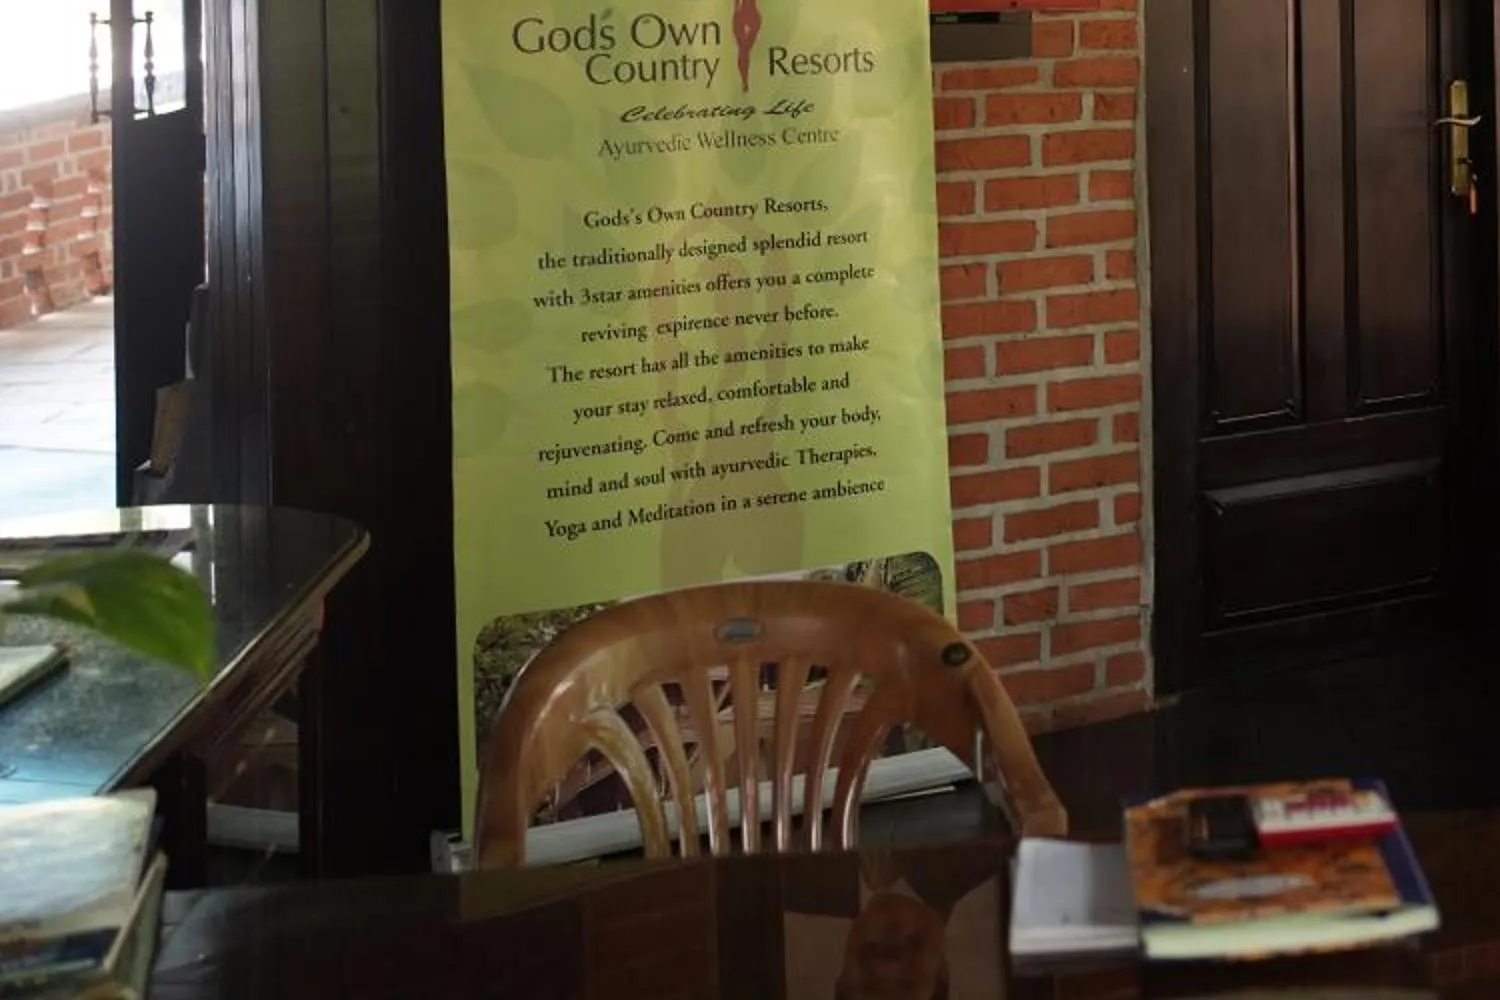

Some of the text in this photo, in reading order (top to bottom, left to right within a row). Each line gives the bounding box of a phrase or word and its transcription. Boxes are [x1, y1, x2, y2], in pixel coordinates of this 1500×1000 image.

[511, 10, 721, 55] God's Own
[585, 46, 875, 89] Country Resorts
[619, 98, 815, 123] Celebrating Life
[598, 127, 840, 162] Ayurvedic Wellness Centre
[647, 206, 686, 224] Own
[689, 202, 759, 220] Country
[538, 230, 868, 271] the traditionally designed splendid resort
[532, 263, 875, 308] with 3star amenities offers you a complete
[581, 302, 839, 343] reviving expirence never before.
[548, 334, 870, 384] The resort has all the amenities to make
[573, 405, 614, 425] your
[617, 399, 649, 417] stay
[716, 375, 817, 401] comfortable
[821, 371, 850, 391] and
[652, 429, 700, 447] Come
[704, 419, 736, 441] and
[739, 414, 795, 436] refresh
[799, 414, 837, 435] your
[546, 476, 593, 500] mind
[598, 471, 630, 493] and
[633, 465, 666, 487] soul
[669, 460, 706, 482] with
[711, 453, 790, 480] ayurvedic
[543, 479, 885, 541] Yoga and Meditation in a serene ambience
